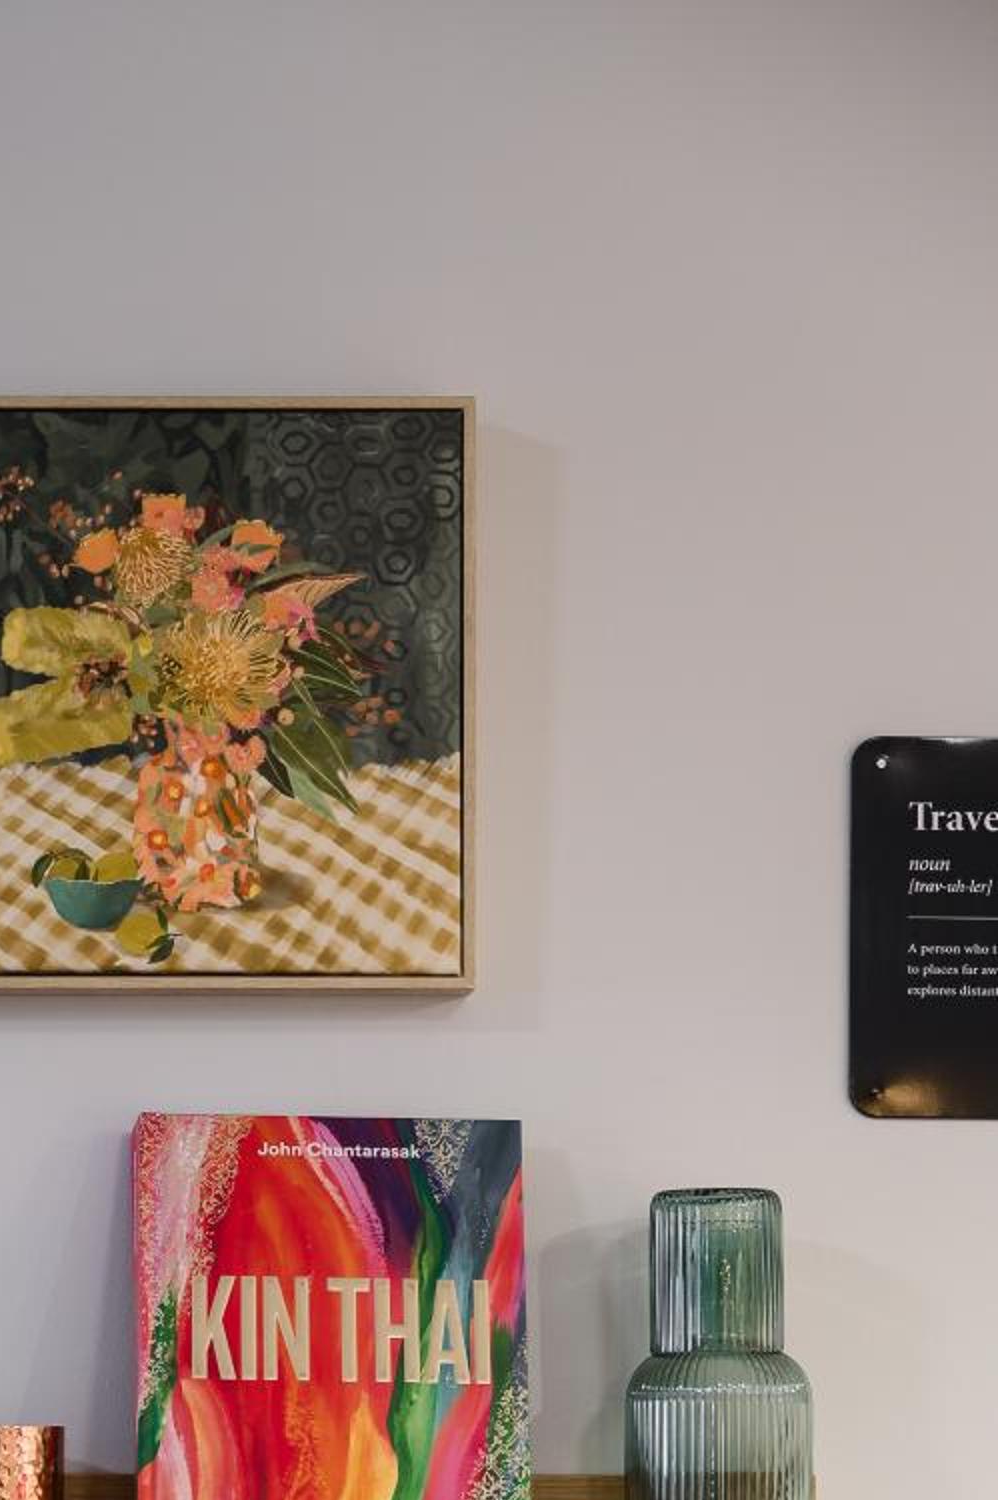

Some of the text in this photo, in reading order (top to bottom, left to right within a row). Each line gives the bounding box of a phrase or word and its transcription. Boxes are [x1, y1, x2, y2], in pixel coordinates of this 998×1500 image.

[908, 801, 998, 832] Trave
[909, 859, 951, 871] noun
[907, 878, 993, 896] [trav-uh-ler]
[907, 943, 918, 953] A
[920, 945, 961, 957] person
[963, 943, 989, 954] who
[907, 965, 919, 975] to
[923, 963, 959, 977] places
[961, 963, 979, 975] far
[907, 984, 956, 999] explores
[257, 1142, 421, 1159] John Chantarasak
[190, 1275, 493, 1385] KIN THAI
